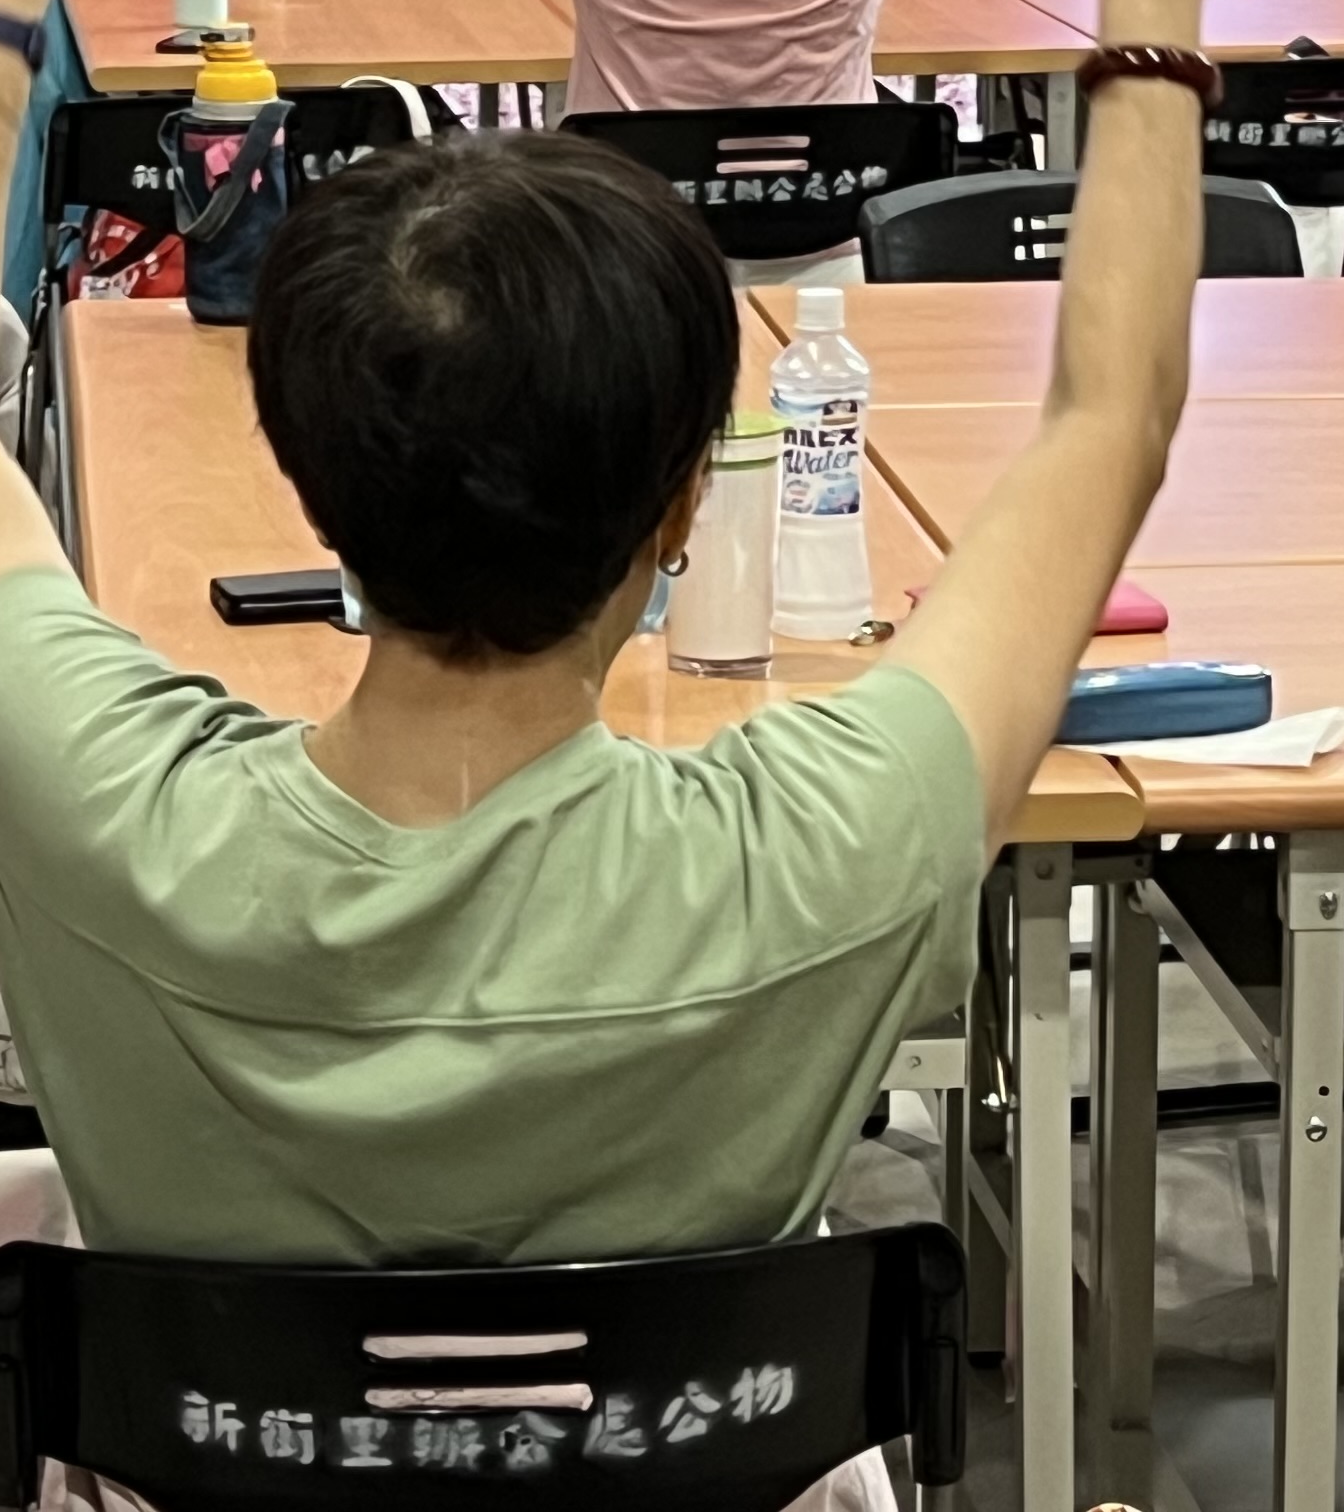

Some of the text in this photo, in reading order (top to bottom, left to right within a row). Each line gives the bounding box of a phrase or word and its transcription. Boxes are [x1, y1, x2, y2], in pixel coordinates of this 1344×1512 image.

[178, 1361, 796, 1470] 新街里辦公處公物
